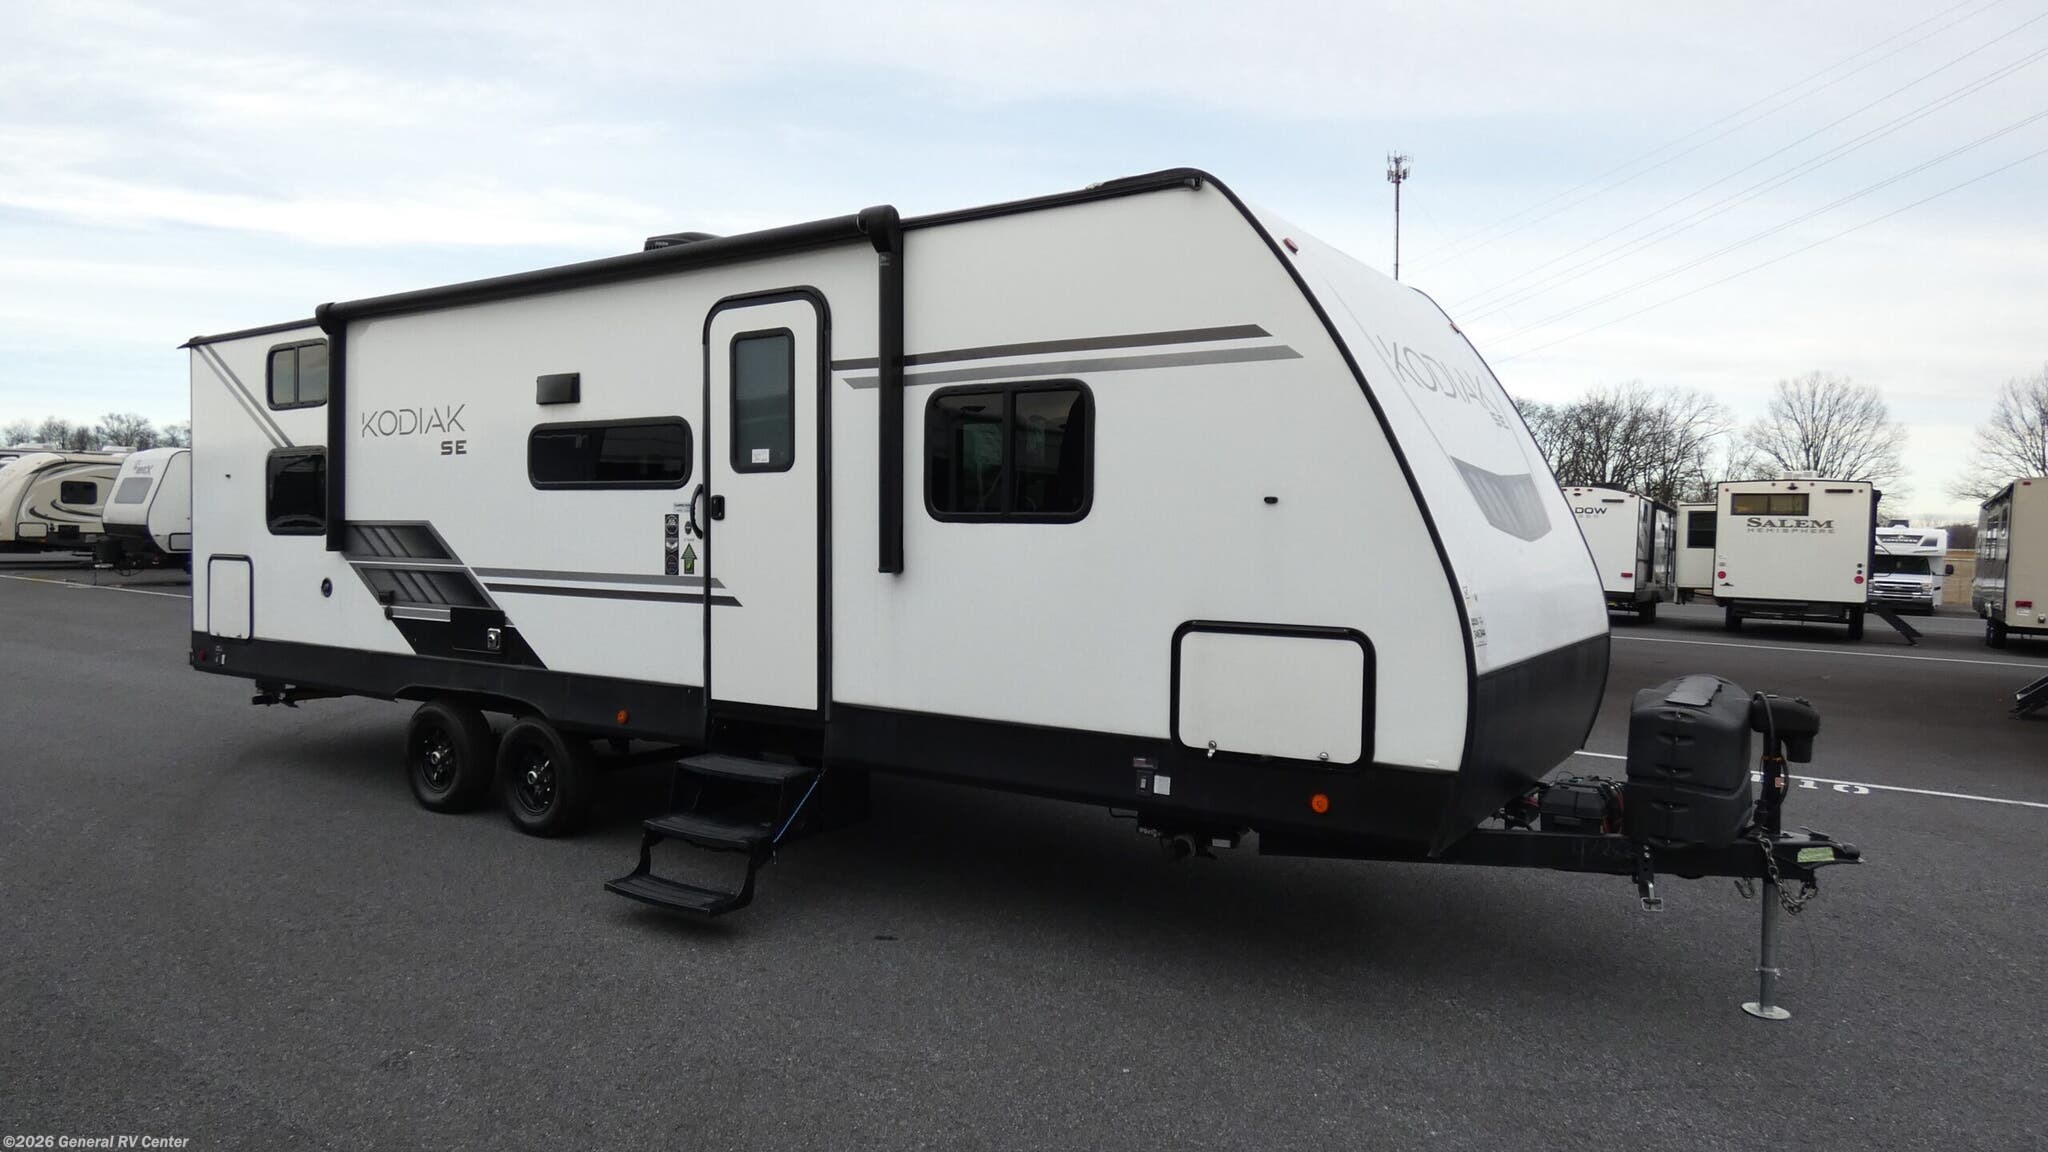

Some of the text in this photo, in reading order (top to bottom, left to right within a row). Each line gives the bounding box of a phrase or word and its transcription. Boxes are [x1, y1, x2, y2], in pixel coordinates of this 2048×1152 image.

[1376, 334, 1501, 414] KODIAK
[361, 404, 466, 438] KODIAK
[440, 440, 467, 455] SE
[1574, 506, 1608, 515] DOW
[1746, 517, 1834, 528] SALEM
